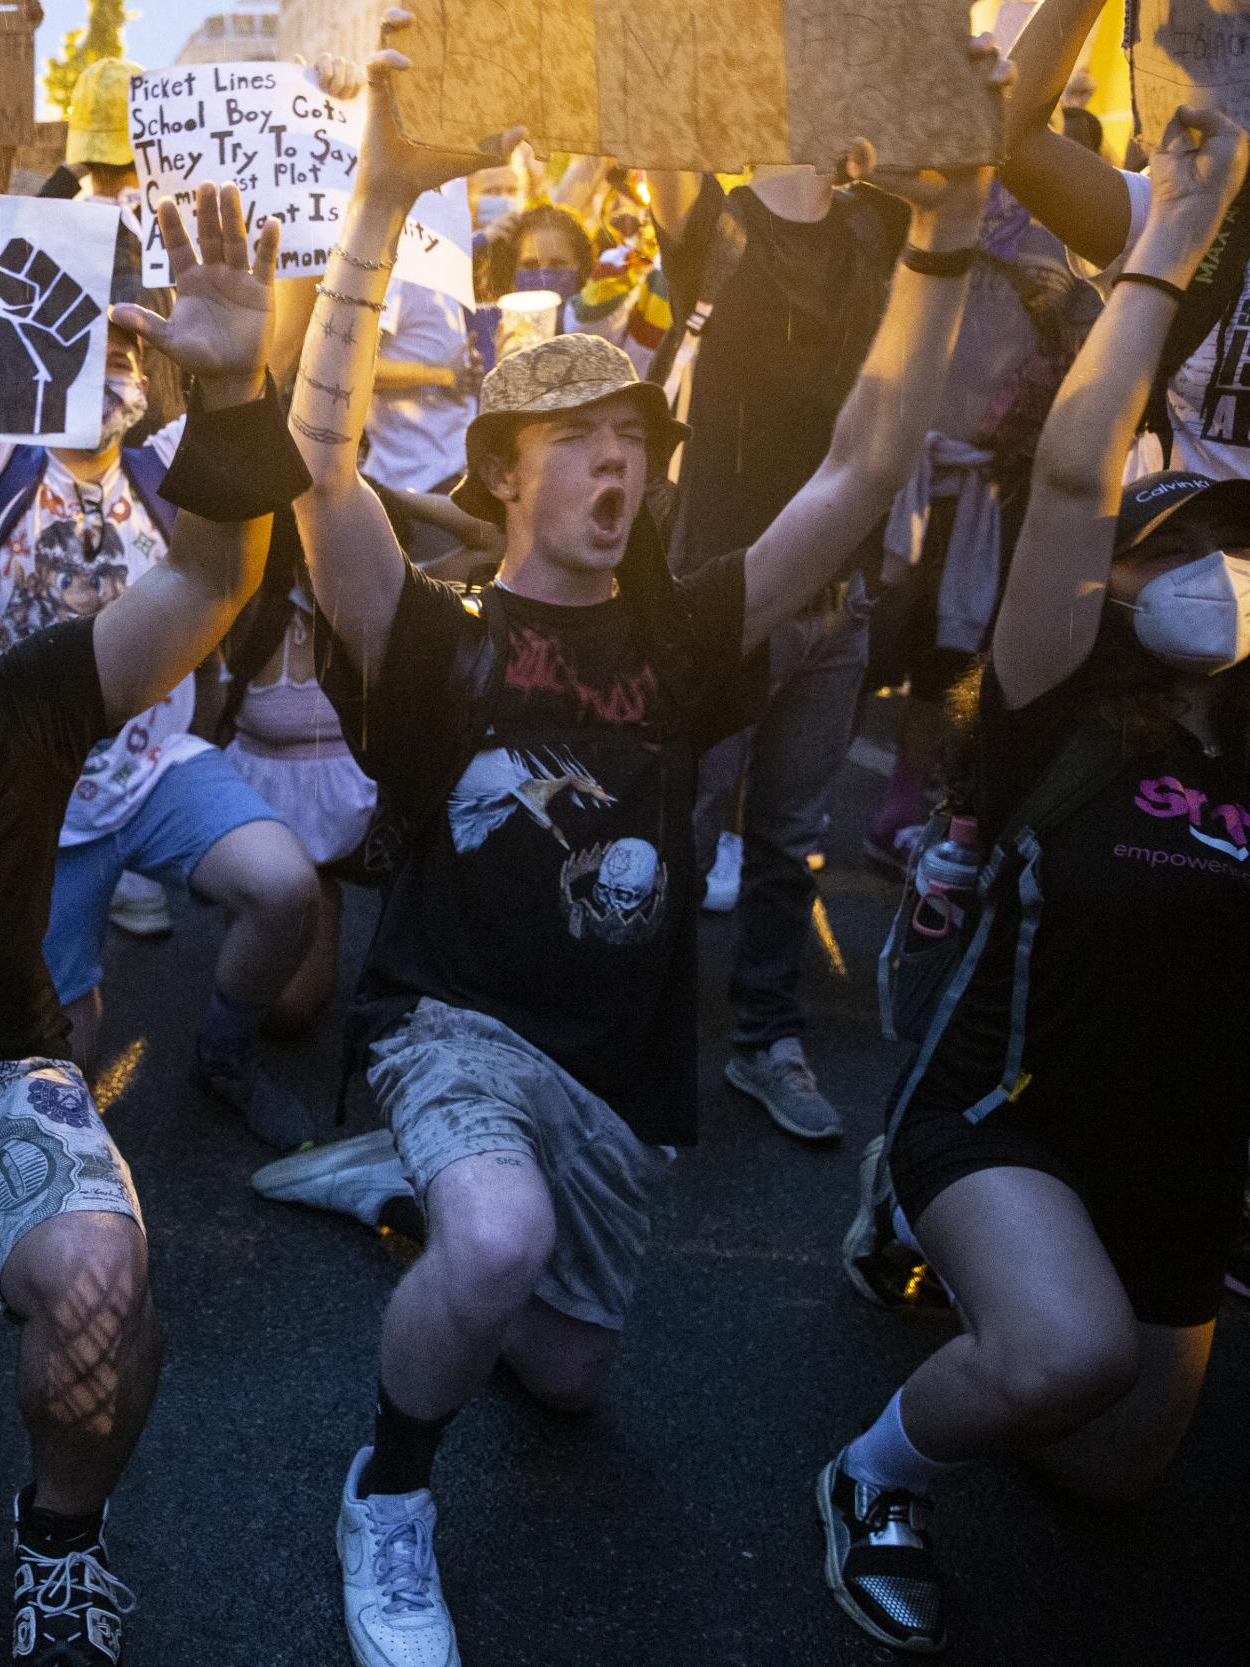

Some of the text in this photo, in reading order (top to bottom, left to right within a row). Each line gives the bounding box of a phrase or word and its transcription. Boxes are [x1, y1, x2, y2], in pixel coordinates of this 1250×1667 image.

[131, 67, 277, 102] Picket Lines
[133, 101, 205, 140] School
[226, 98, 273, 134] Boy
[135, 124, 358, 180] They Try To Say
[275, 162, 321, 187] Plot
[308, 192, 339, 222] Is
